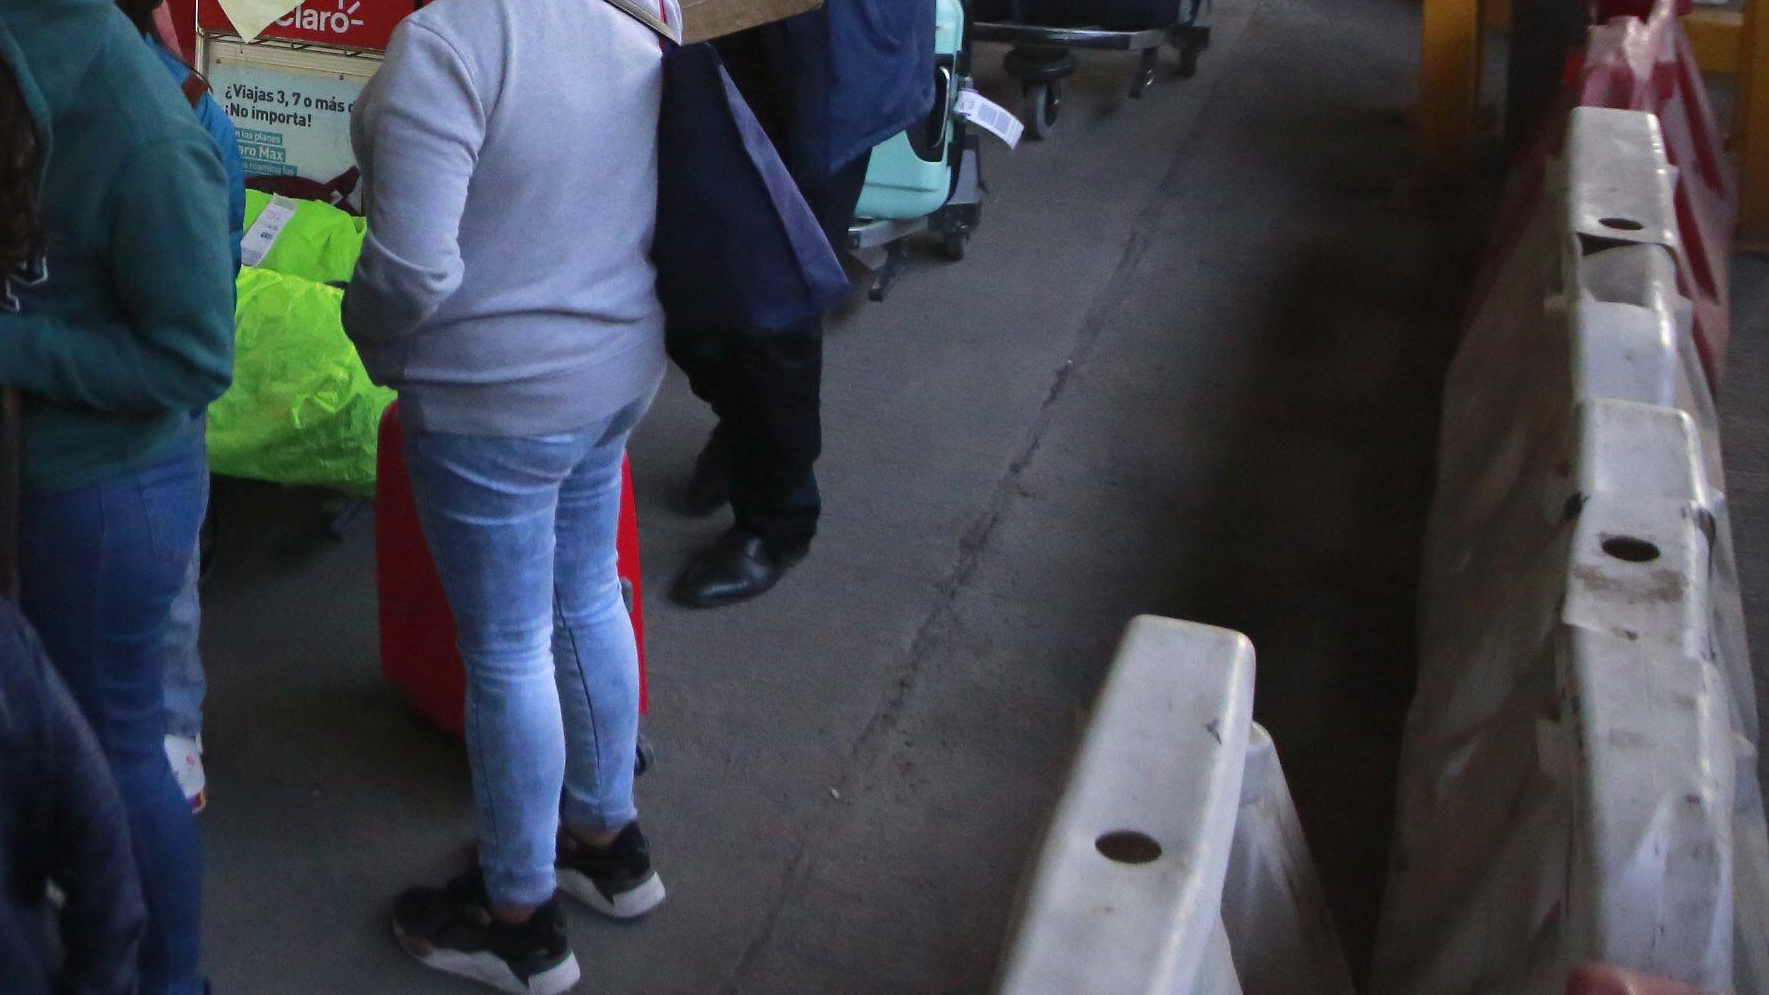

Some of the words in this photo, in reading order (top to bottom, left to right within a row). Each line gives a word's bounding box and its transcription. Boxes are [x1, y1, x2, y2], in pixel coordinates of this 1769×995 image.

[224, 83, 275, 103] ¿Viajas
[276, 90, 290, 107] 3,
[291, 92, 302, 107] 7
[303, 97, 313, 108] o
[314, 96, 346, 113] más
[224, 103, 249, 118] ¡No
[251, 106, 312, 128] importa!
[258, 145, 284, 161] Max
